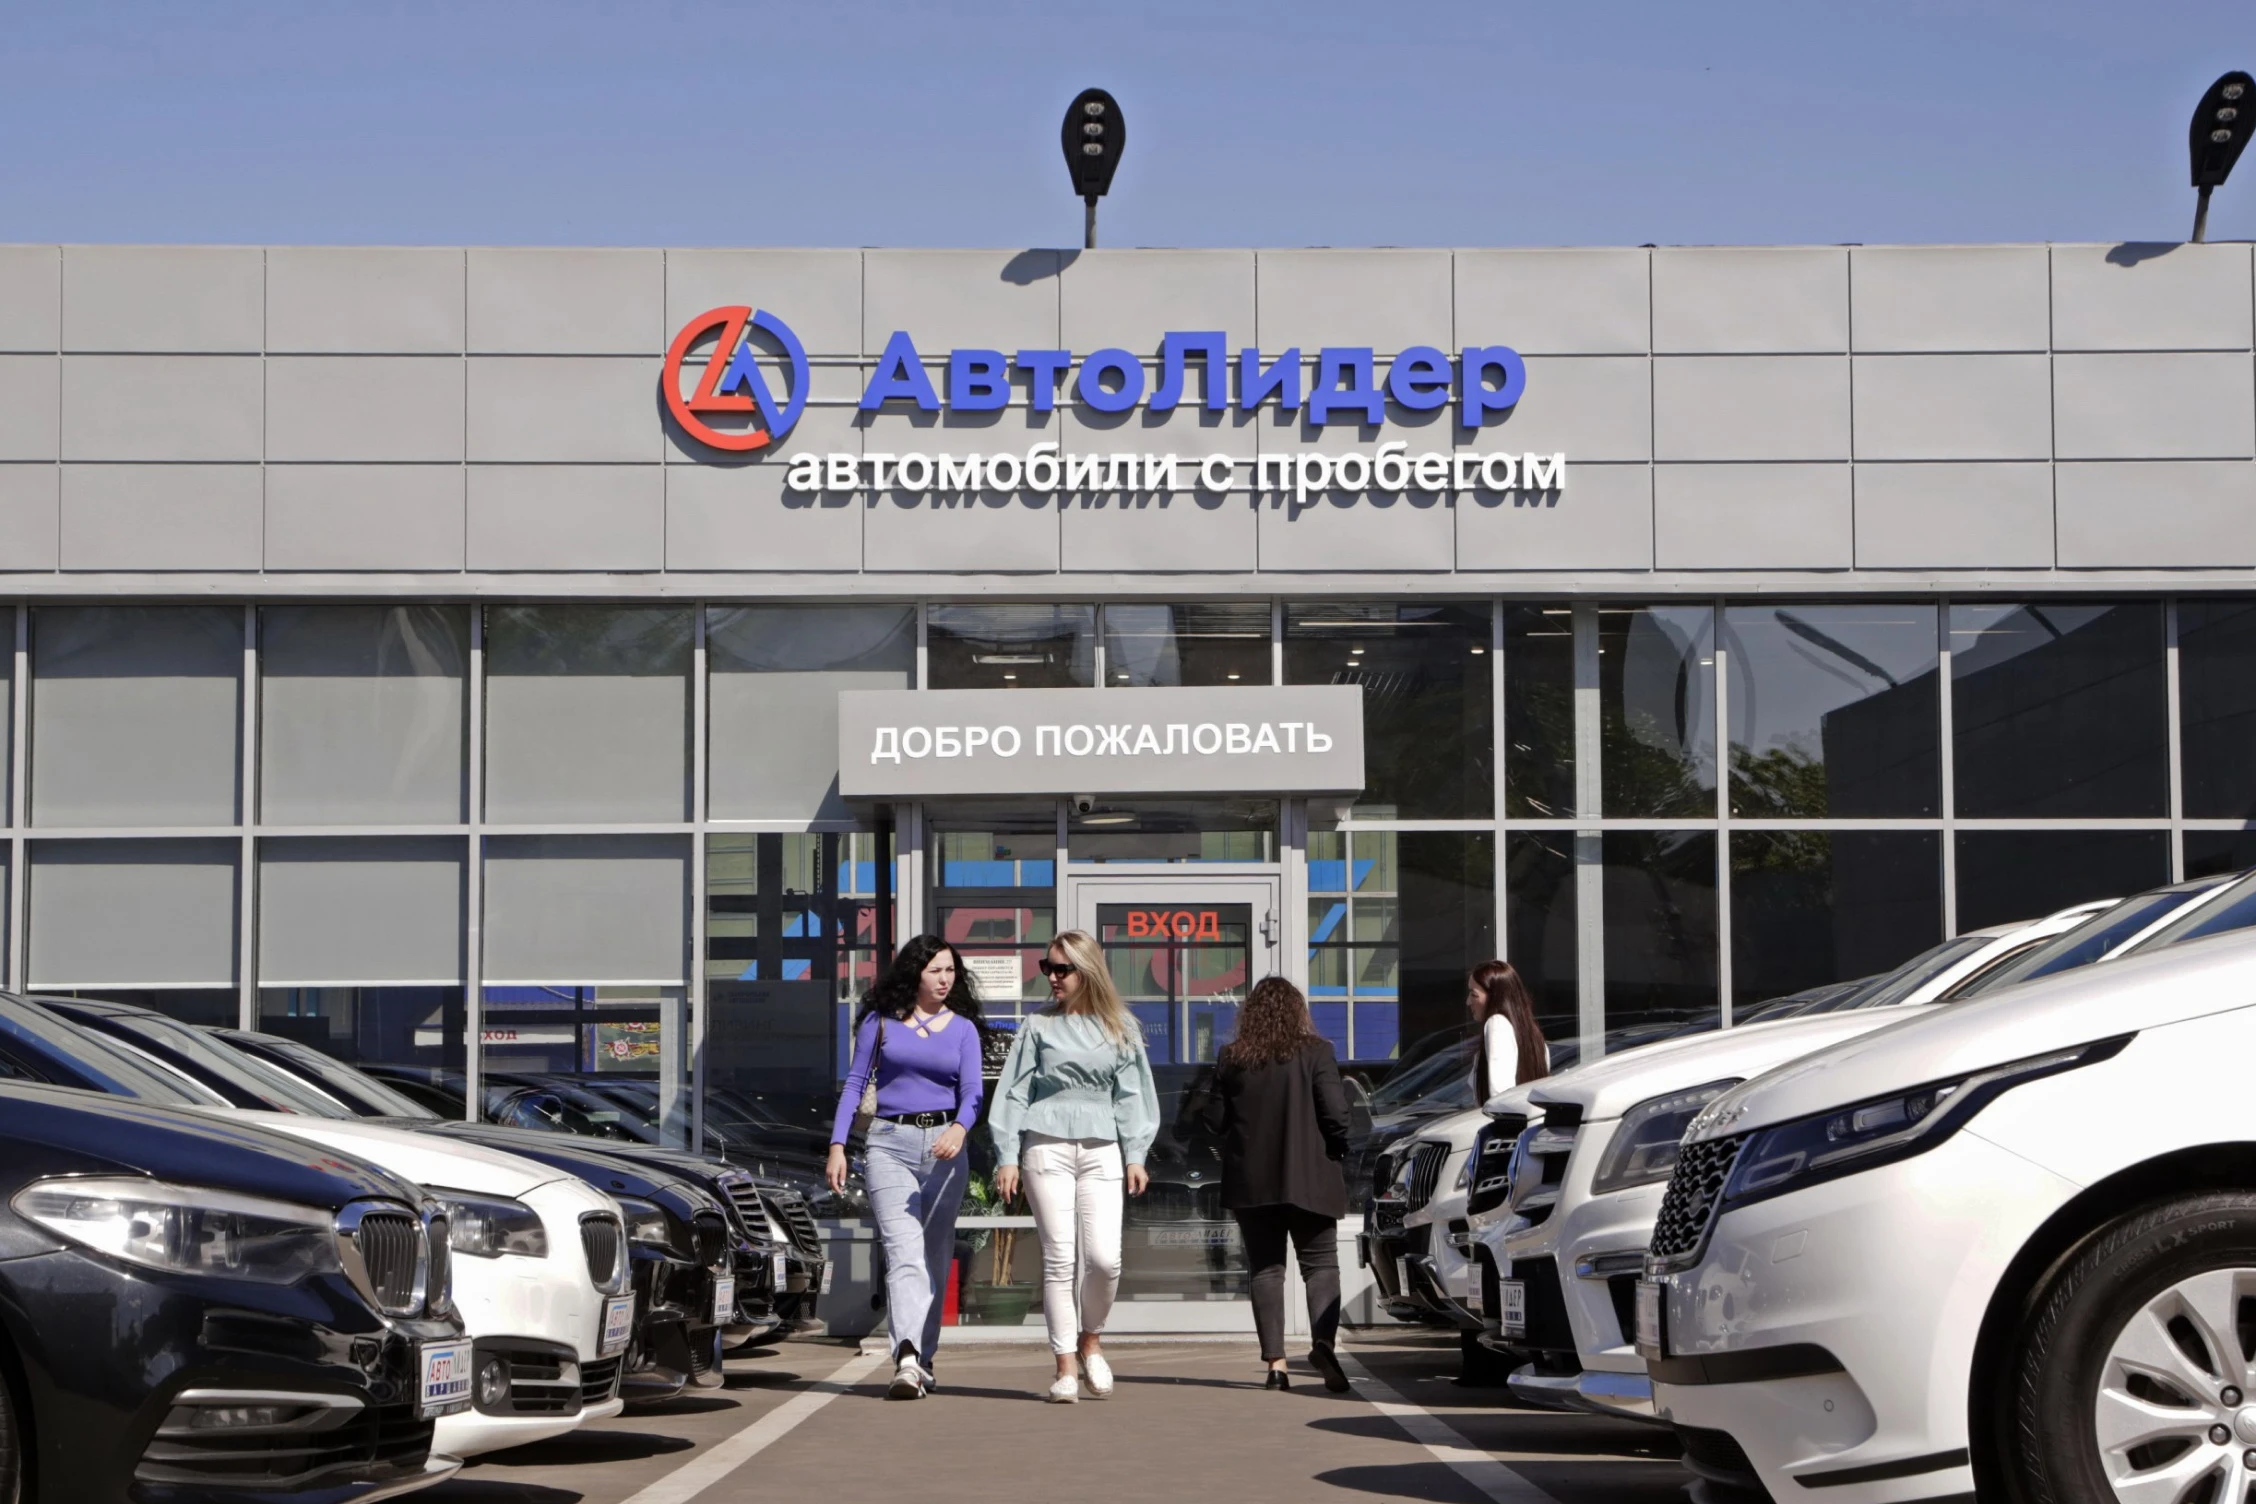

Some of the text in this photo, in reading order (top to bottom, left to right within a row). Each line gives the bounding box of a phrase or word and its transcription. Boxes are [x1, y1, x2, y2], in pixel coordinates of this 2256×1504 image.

[858, 331, 1526, 428] АвтоЛидер
[787, 440, 1567, 503] автомобили с пробегом
[870, 722, 1333, 765] ДОБРО ПОЖАЛОВАТЬ
[1127, 911, 1220, 942] ВХОД
[2188, 1219, 2236, 1236] SPORT
[430, 1359, 451, 1382] АВТО
